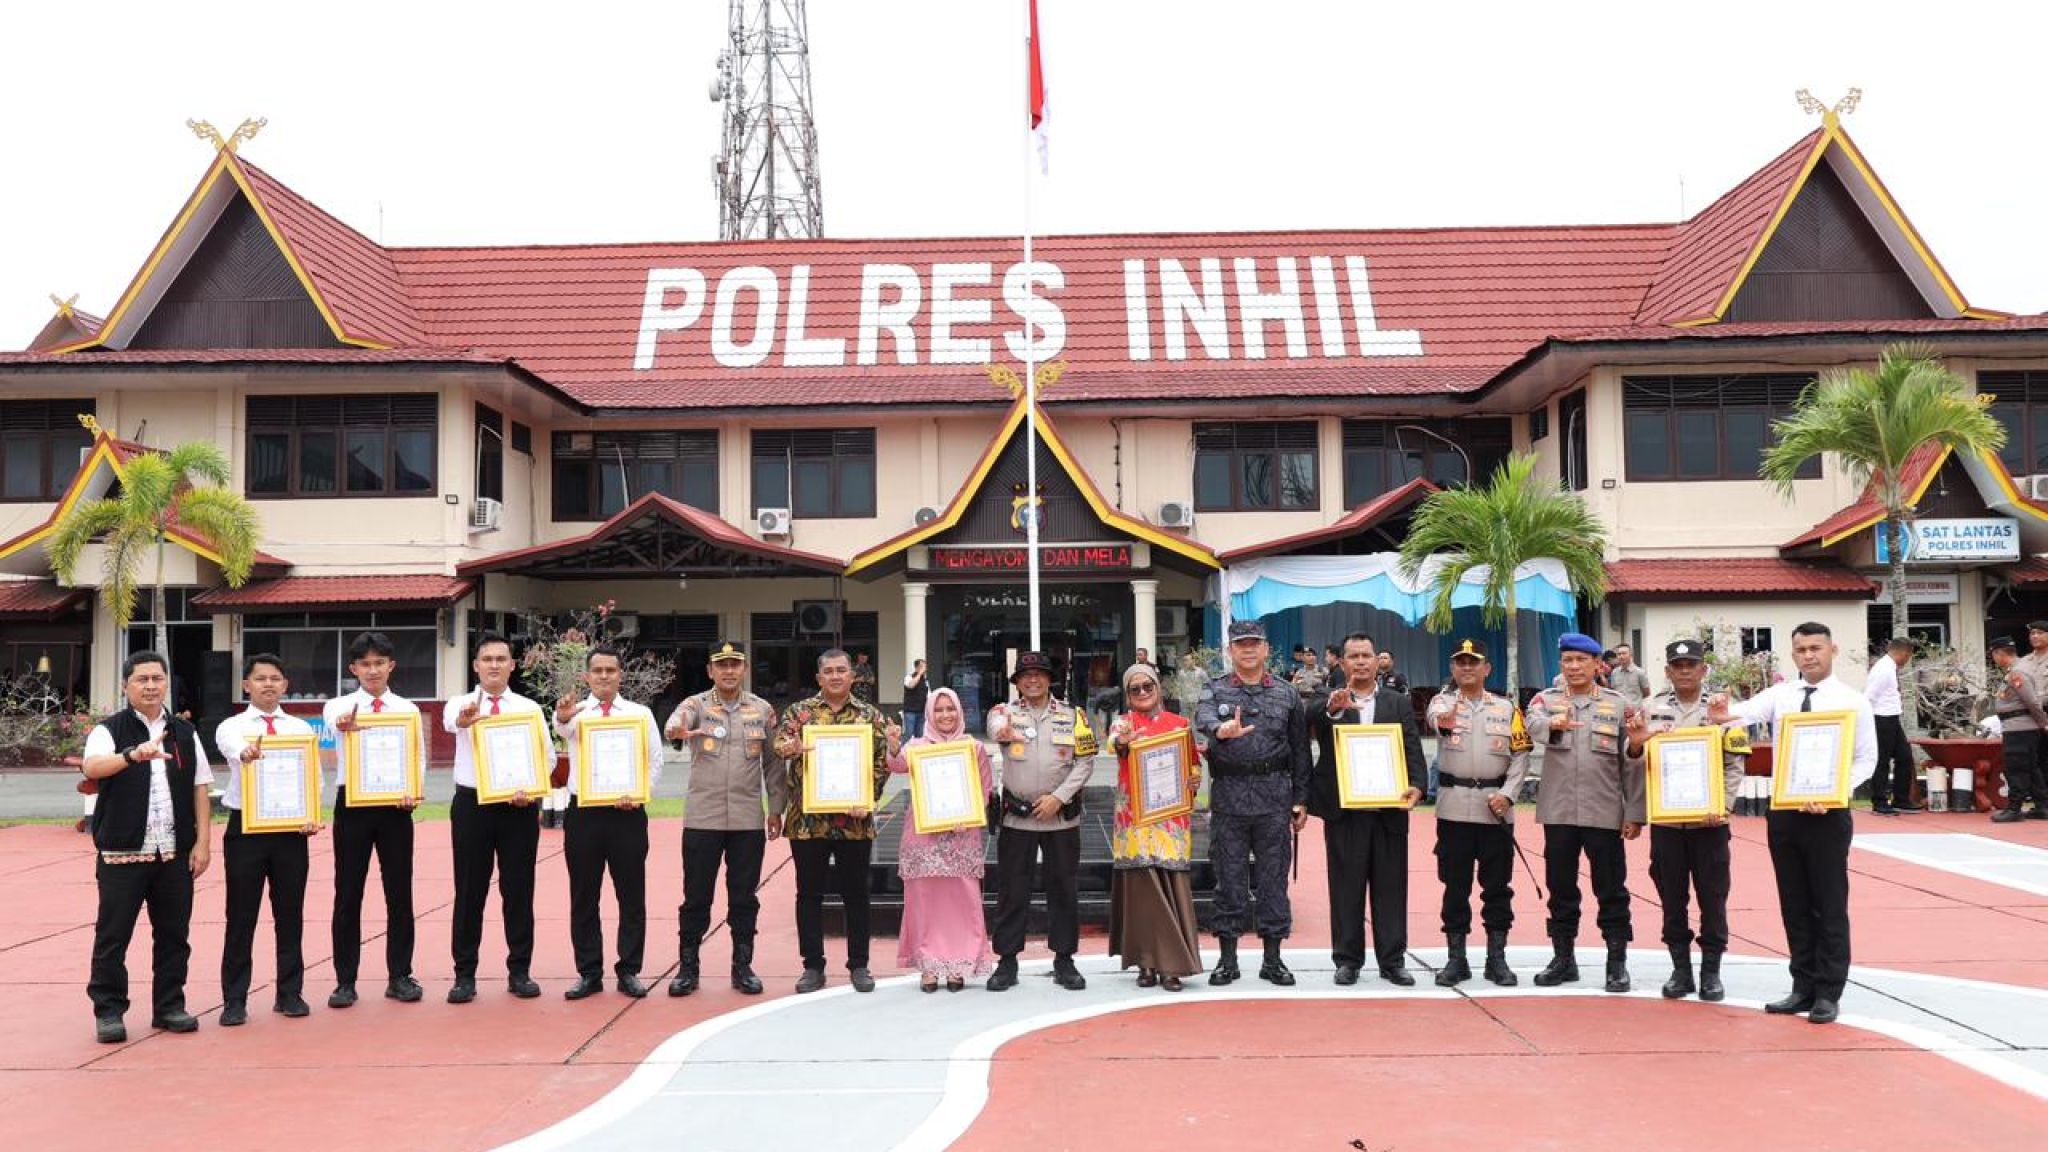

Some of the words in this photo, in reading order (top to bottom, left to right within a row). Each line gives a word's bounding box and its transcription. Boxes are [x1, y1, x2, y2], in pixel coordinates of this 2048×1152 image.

[634, 262, 1066, 370] POLRES
[1123, 255, 1424, 361] INHIL
[1922, 526, 1949, 538] SAT
[1954, 525, 2012, 538] LANTAS
[1928, 541, 1973, 550] POLRES
[1976, 540, 2007, 550] INHIL
[936, 549, 1029, 567] MENGAYOM
[1043, 549, 1079, 566] DAN
[1084, 547, 1129, 566] MELA
